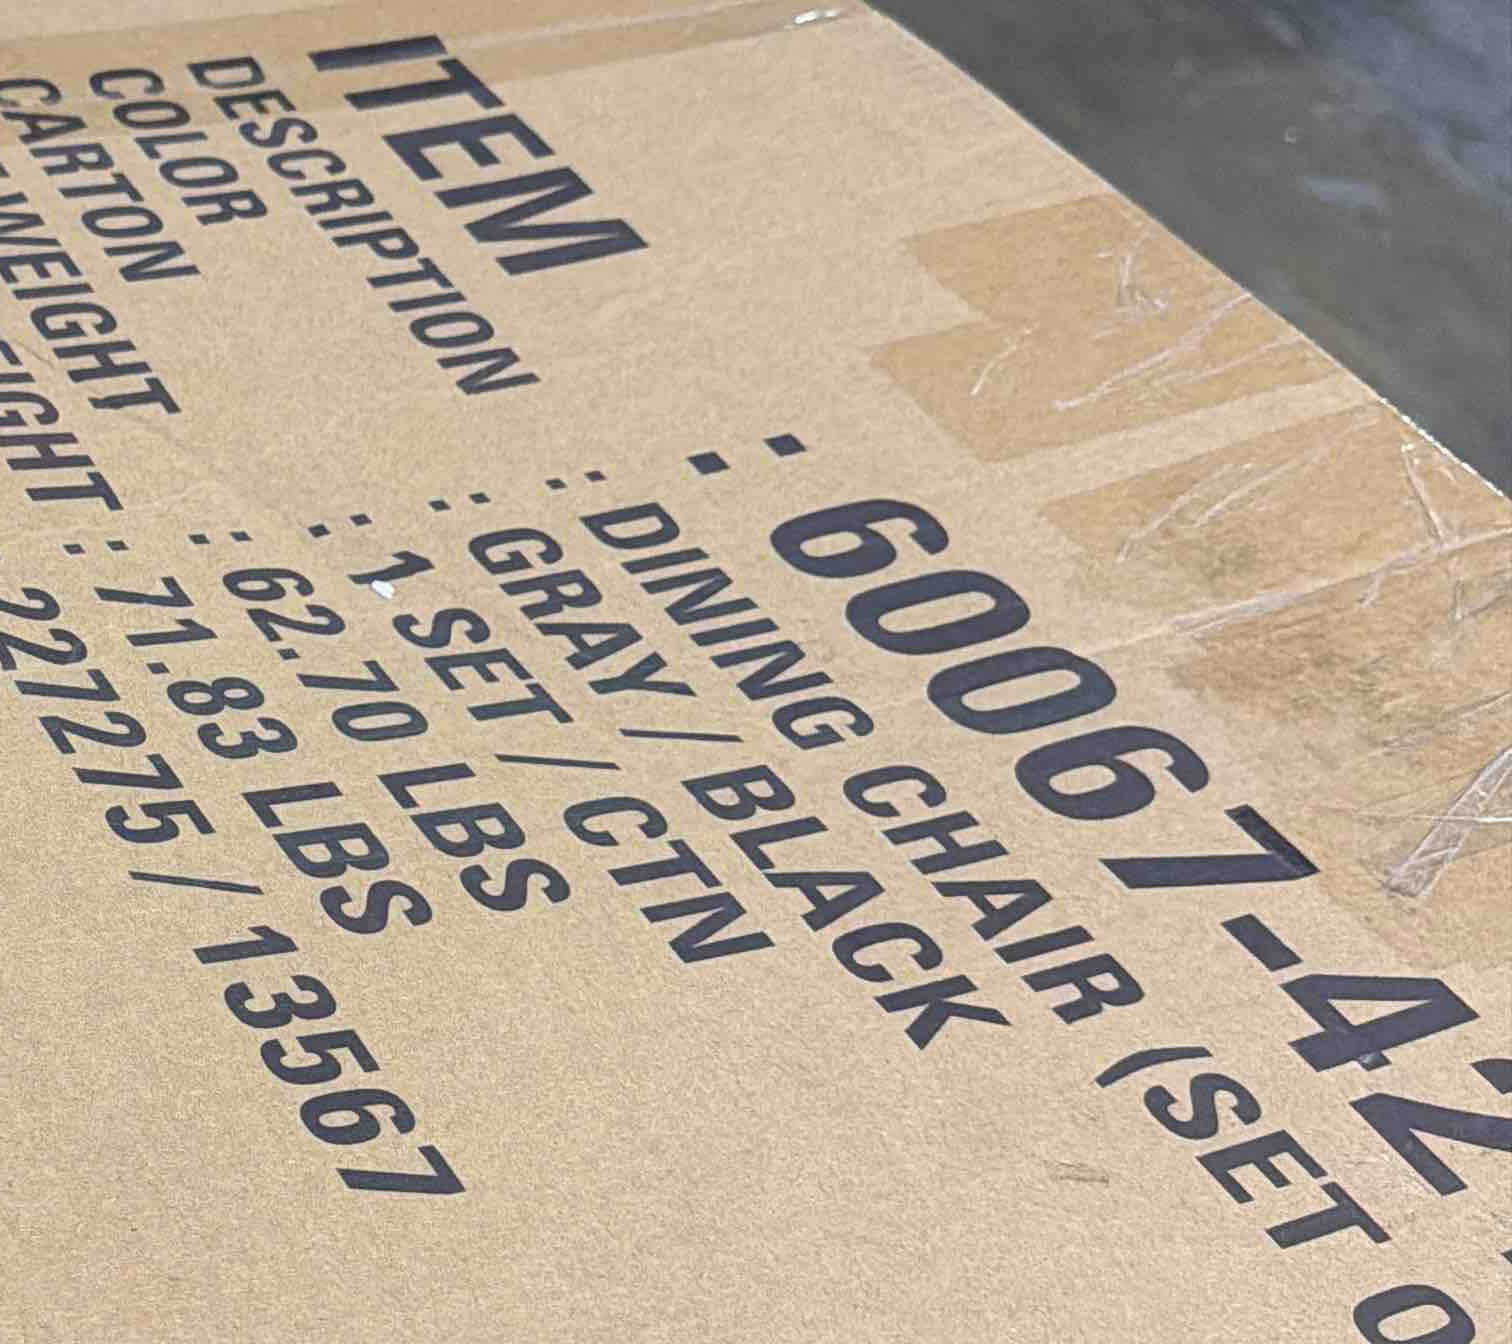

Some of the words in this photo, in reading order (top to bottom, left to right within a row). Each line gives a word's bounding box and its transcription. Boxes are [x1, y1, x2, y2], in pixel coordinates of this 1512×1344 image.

[308, 35, 648, 275] ITEM
[90, 69, 267, 225] COLOR
[469, 528, 696, 696] GRAY
[620, 729, 742, 742] /
[682, 765, 1011, 1049] BLACK
[189, 56, 541, 395] DESCRIPTION
[580, 503, 873, 749] DINING
[844, 766, 1144, 1024] CHAIR
[1096, 1047, 1390, 1248] (SET
[95, 577, 300, 759] 71.83
[242, 782, 432, 934] LBS
[130, 872, 264, 894] /
[223, 568, 428, 741] 62.70
[378, 763, 570, 911] LBS
[349, 551, 434, 584] 1
[393, 608, 573, 723] SET
[496, 755, 620, 770] /
[564, 797, 774, 963] CTN
[194, 926, 465, 1194] 13567
